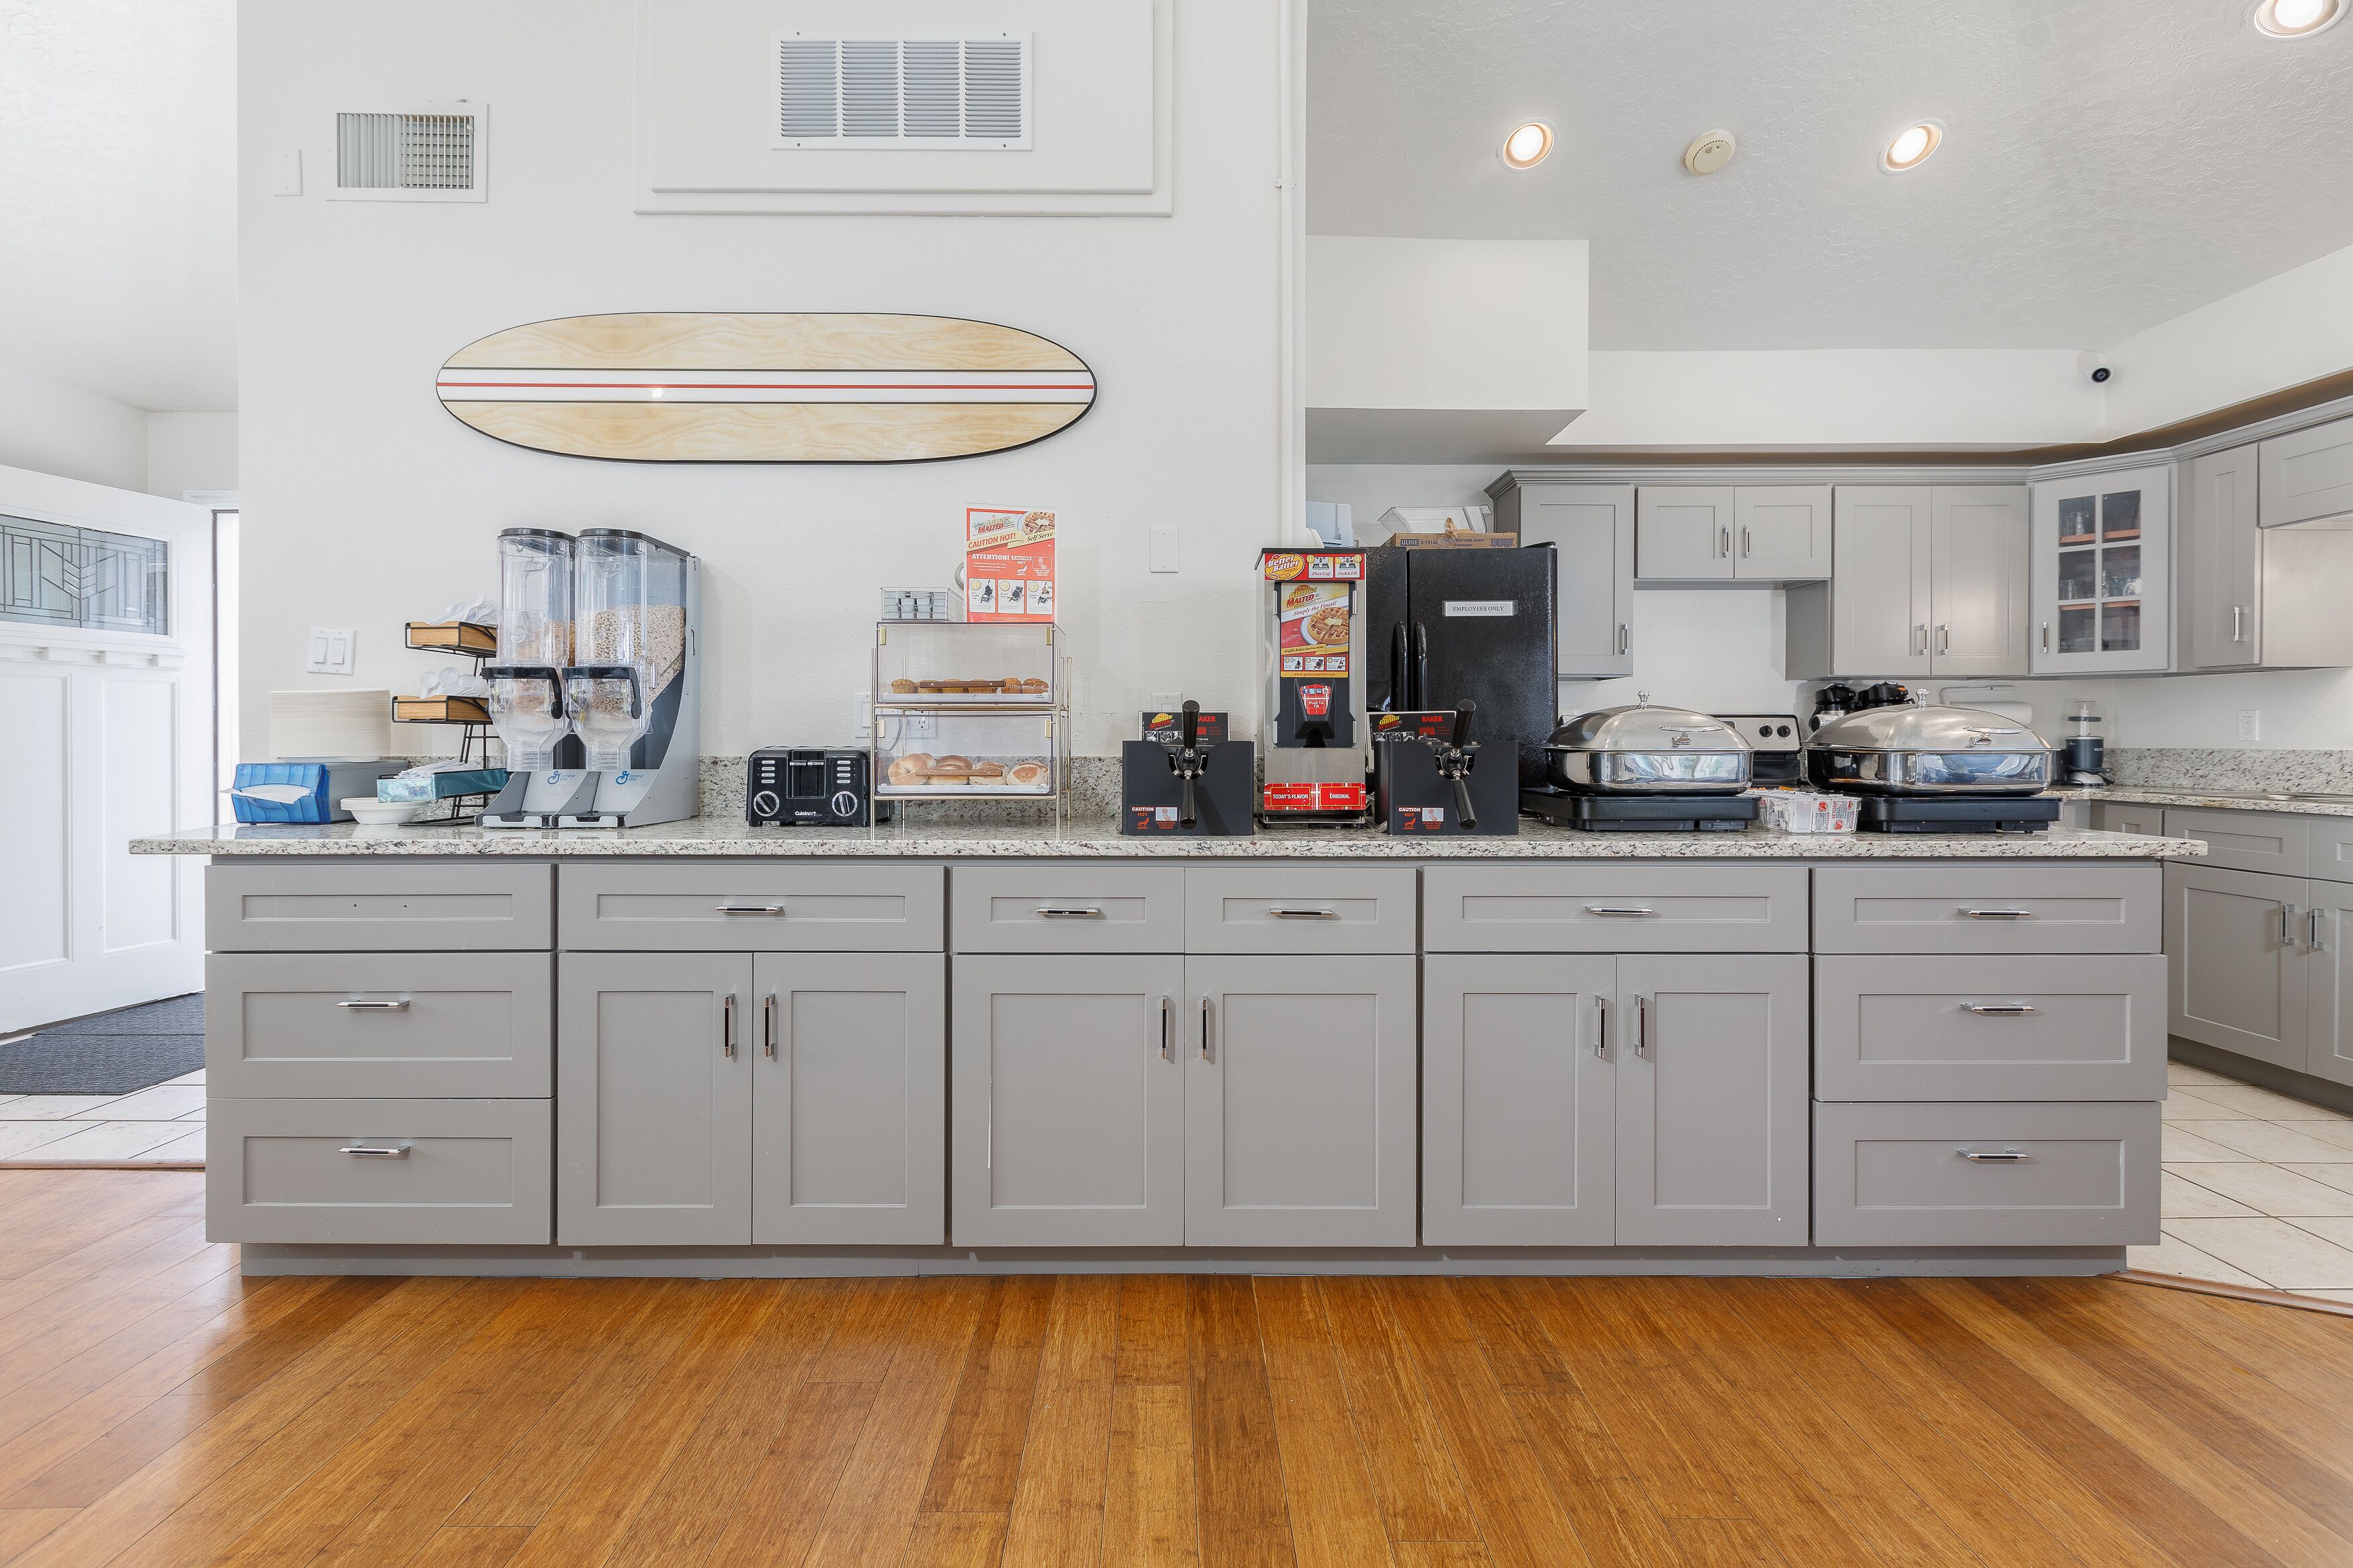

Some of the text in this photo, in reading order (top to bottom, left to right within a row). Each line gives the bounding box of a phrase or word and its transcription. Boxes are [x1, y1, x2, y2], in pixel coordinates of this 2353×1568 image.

[978, 524, 1004, 534] MALTED
[968, 532, 1016, 549] CAUTION HOT!
[1268, 554, 1295, 567] Better
[1273, 560, 1300, 572] Batter
[1289, 586, 1317, 599] GOLDEN
[1286, 594, 1314, 606] MALTED
[1293, 608, 1310, 616] Simply
[1320, 601, 1337, 609] Finest!
[1150, 719, 1171, 729] MALTED
[1152, 714, 1172, 724] GOLDEN
[1379, 715, 1400, 725] GOLDEN
[1378, 720, 1398, 731] MALTED
